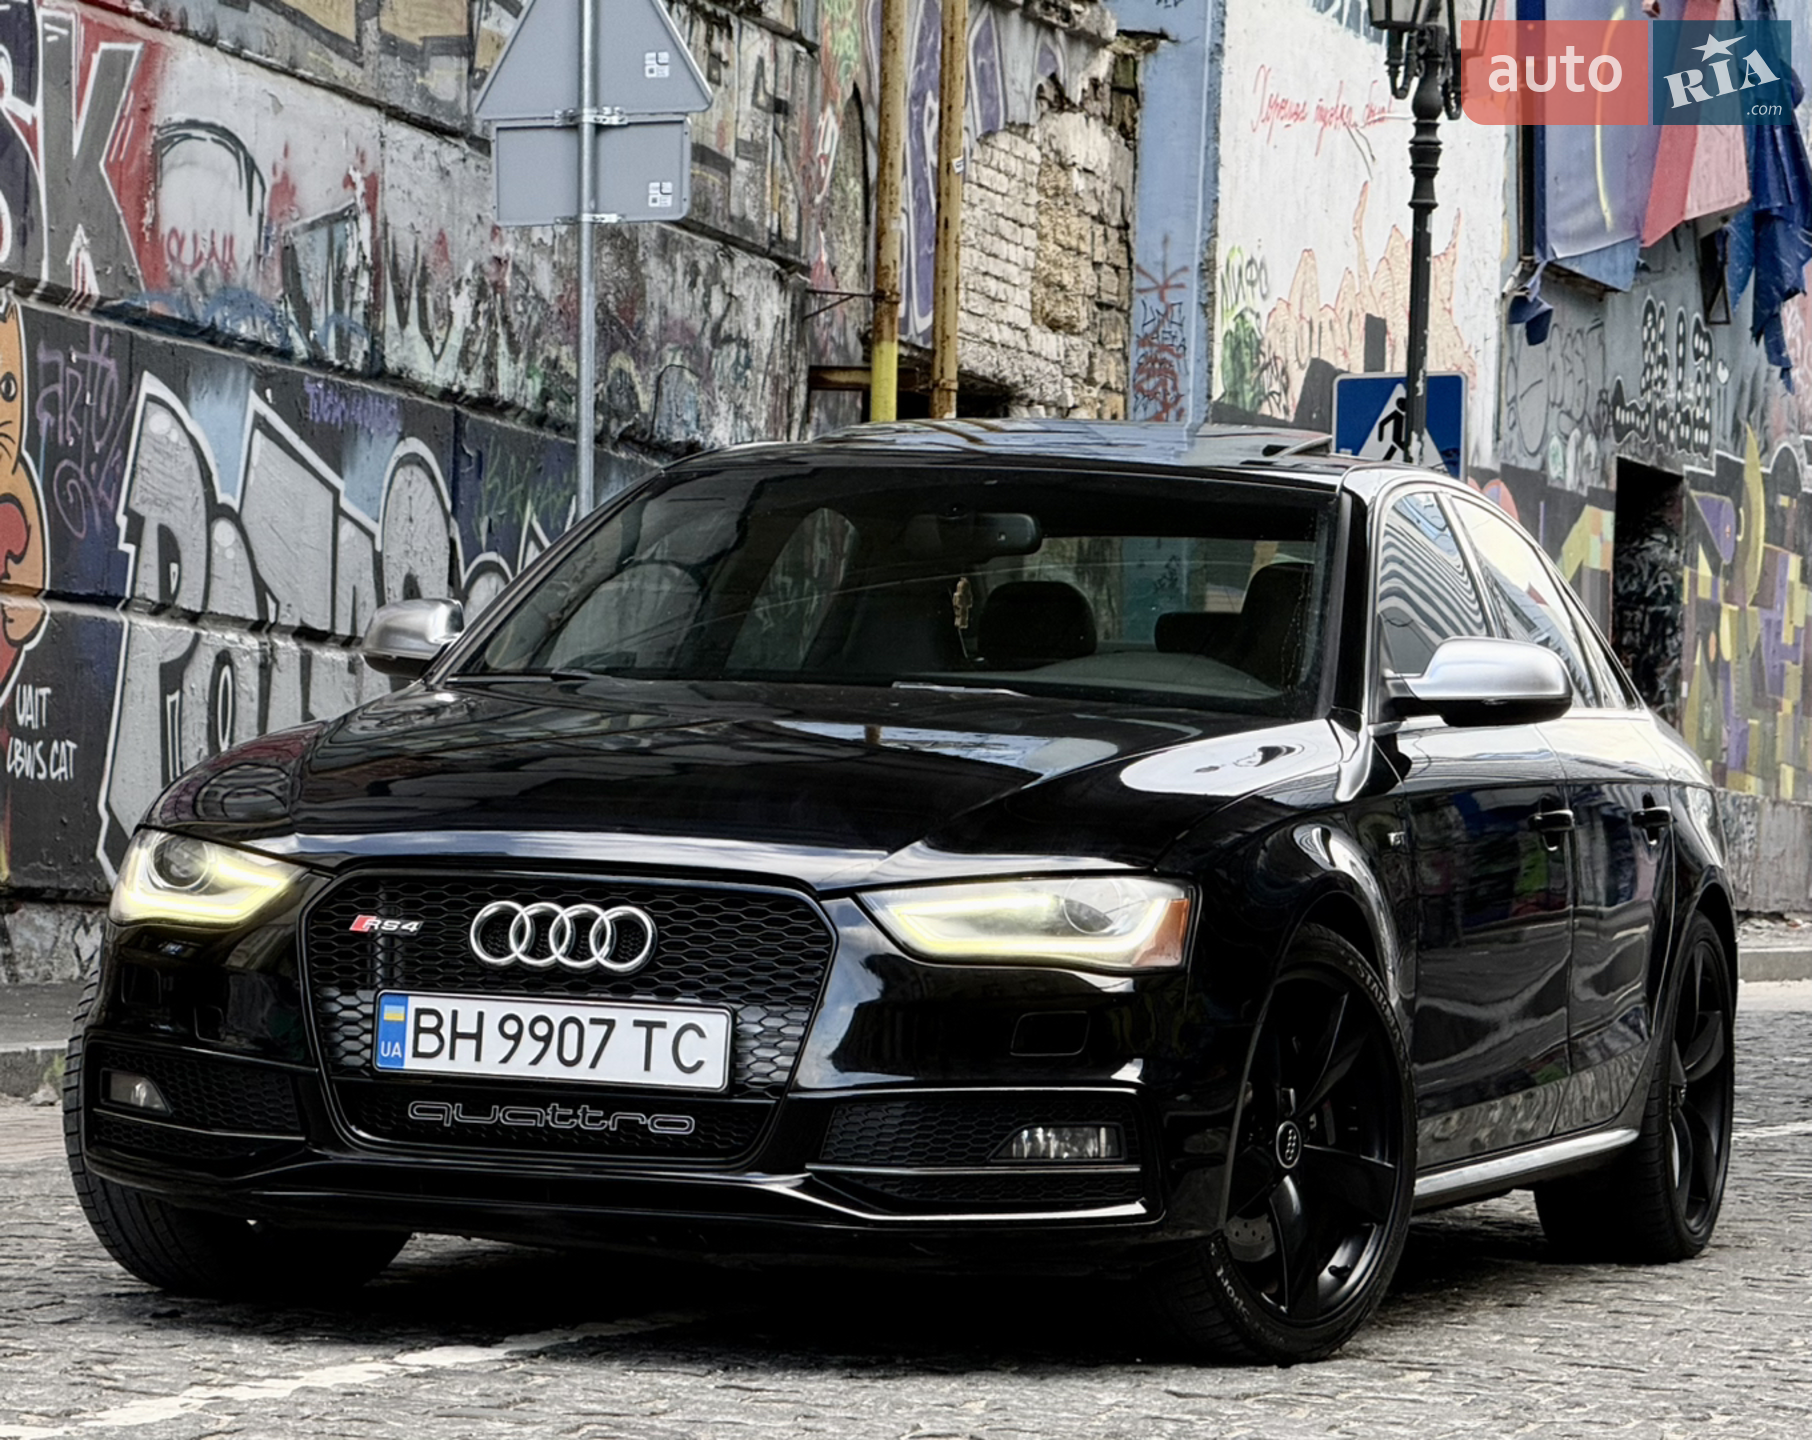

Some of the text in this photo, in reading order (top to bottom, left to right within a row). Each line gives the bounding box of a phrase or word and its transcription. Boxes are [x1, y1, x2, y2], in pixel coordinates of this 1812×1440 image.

[49, 739, 78, 782] CAT
[360, 918, 421, 934] RS4
[380, 1041, 402, 1058] UA
[412, 1007, 707, 1074] BH 9907 TC
[408, 1101, 695, 1135] quattro
